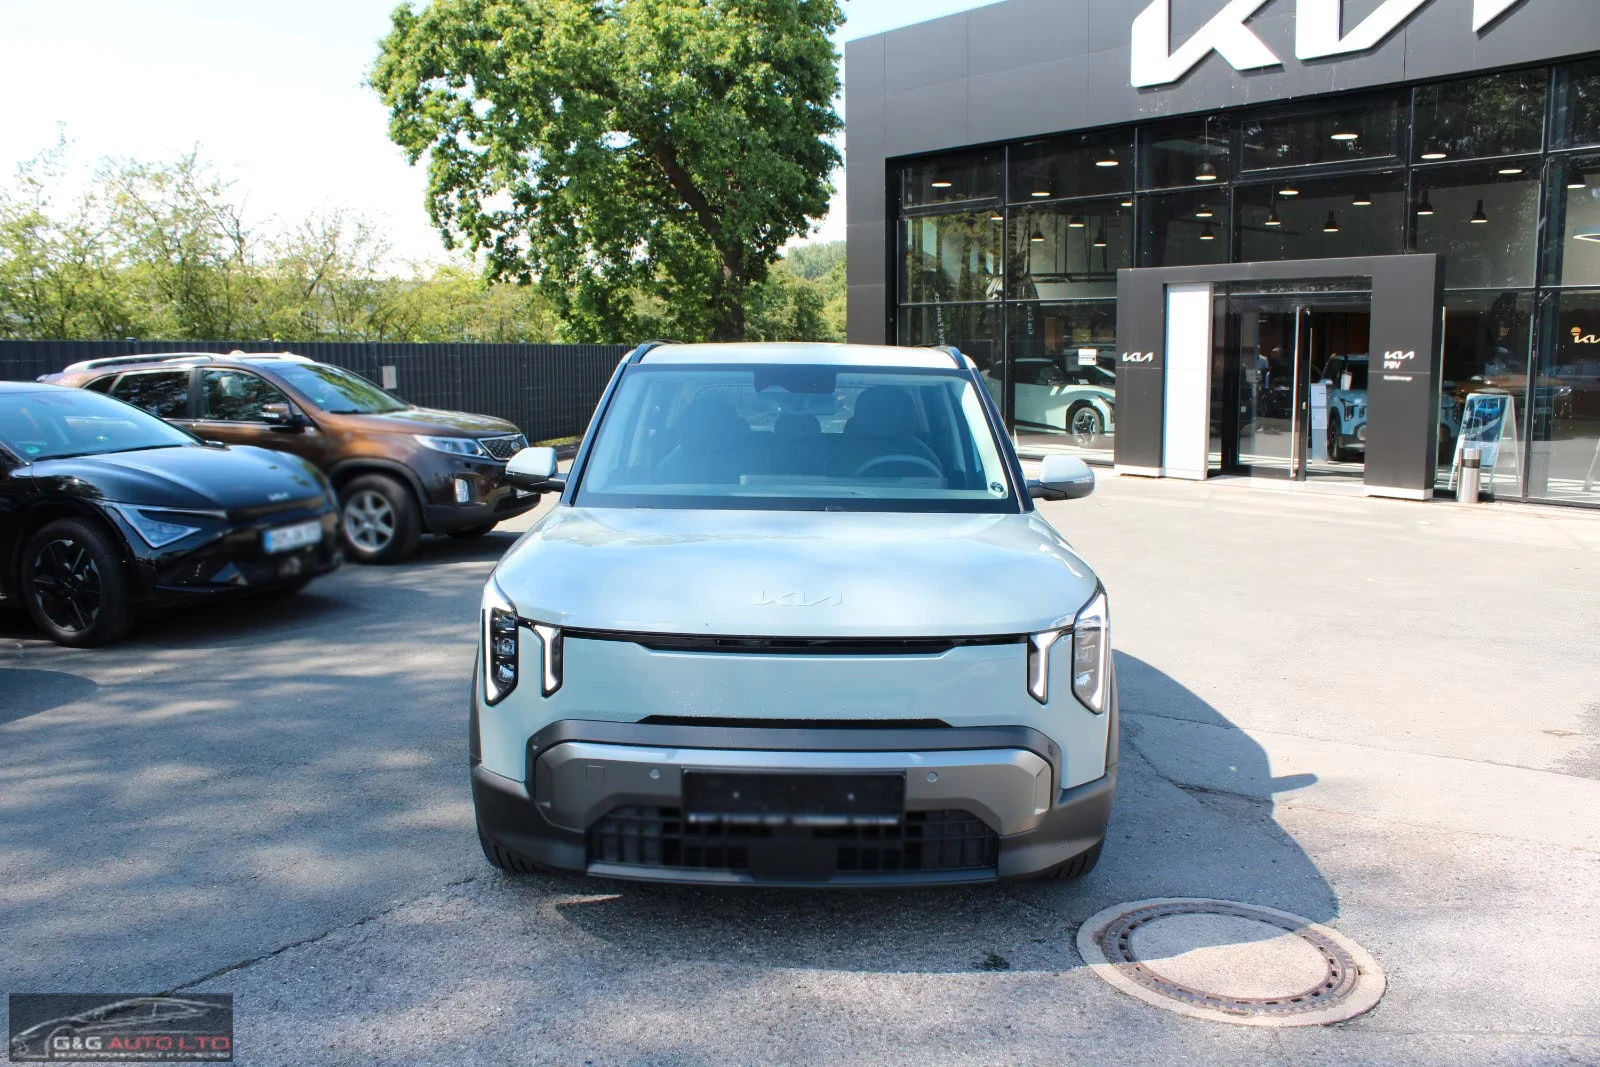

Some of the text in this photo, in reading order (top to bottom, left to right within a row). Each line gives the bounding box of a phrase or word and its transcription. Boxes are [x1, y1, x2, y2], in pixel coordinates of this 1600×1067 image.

[1574, 335, 1600, 343] KI
[1122, 352, 1154, 362] KIA
[1384, 351, 1415, 360] KIA
[752, 590, 843, 607] KIA
